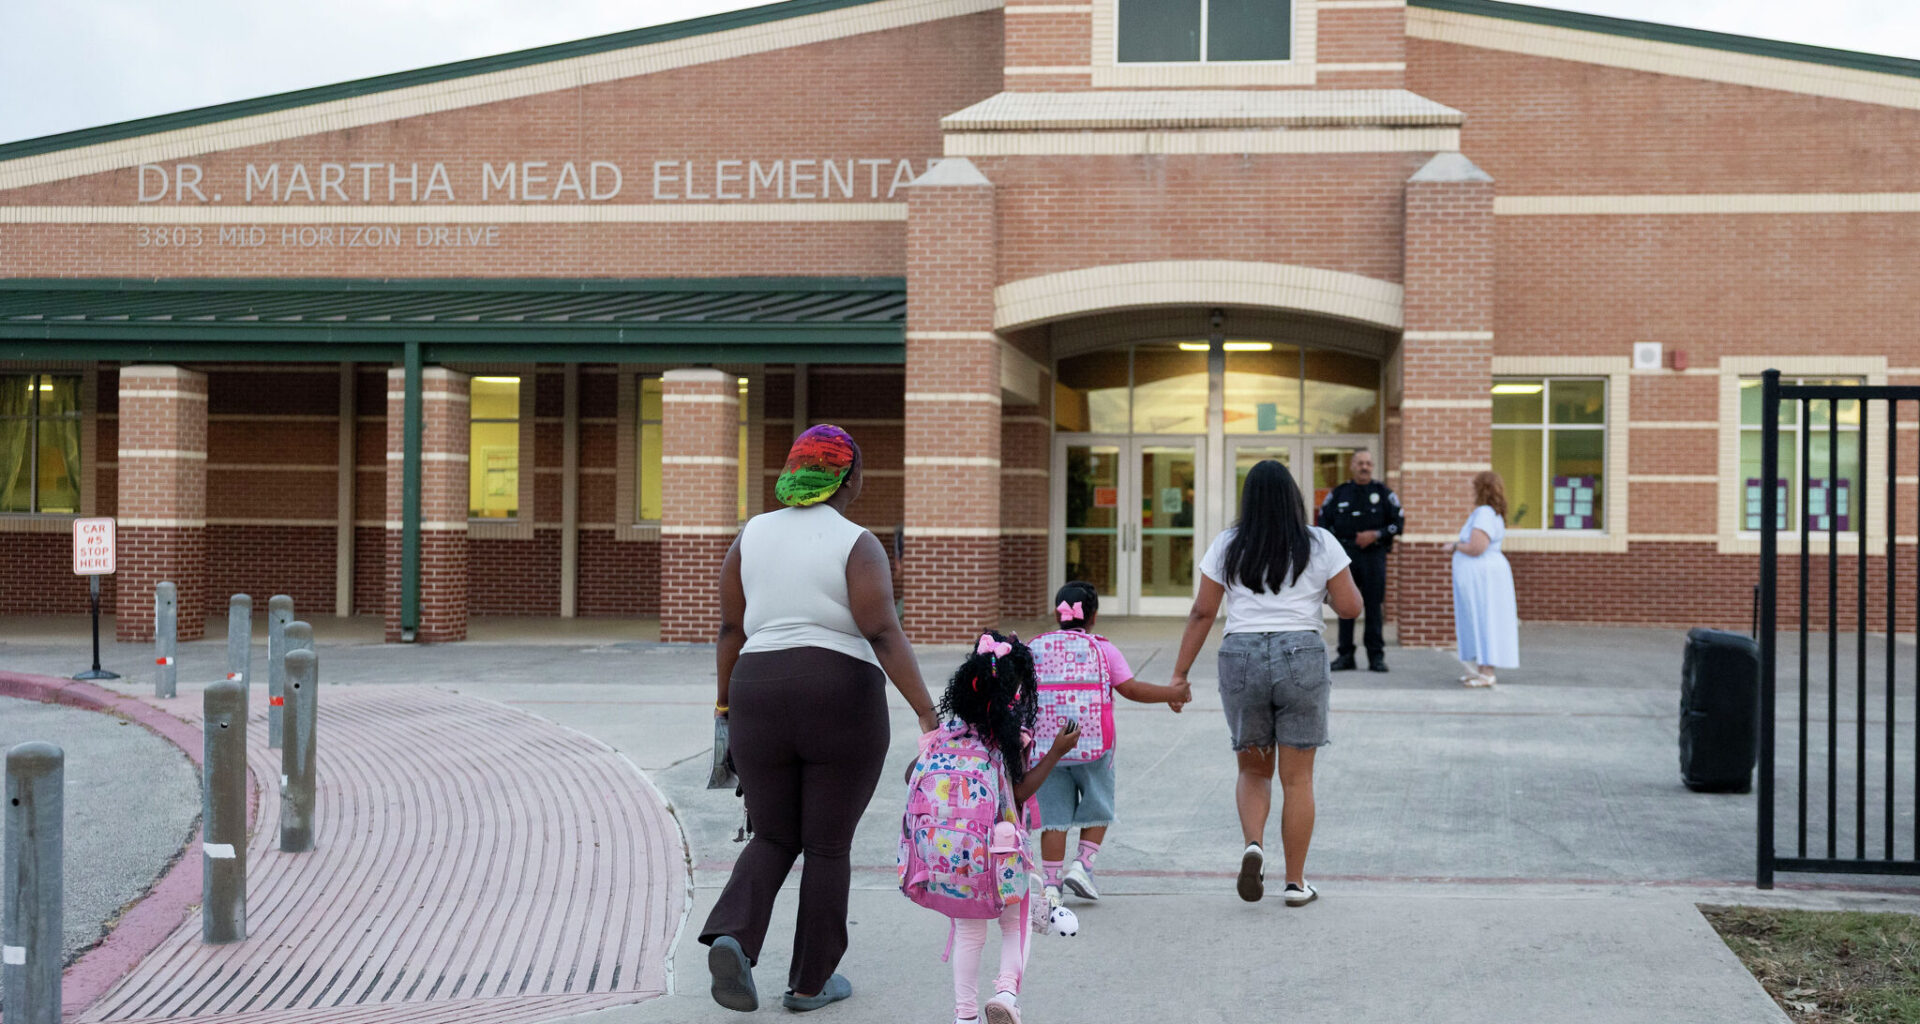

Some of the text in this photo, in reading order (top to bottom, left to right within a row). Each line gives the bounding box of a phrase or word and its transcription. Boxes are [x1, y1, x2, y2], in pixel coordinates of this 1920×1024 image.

[138, 158, 943, 202] DR. MARTHA MEAD ELEMENTA
[137, 226, 500, 248] 3803 MID HORIZON DRIVE
[83, 524, 106, 534] CAR
[80, 546, 109, 557] STOP
[80, 558, 108, 568] HERE
